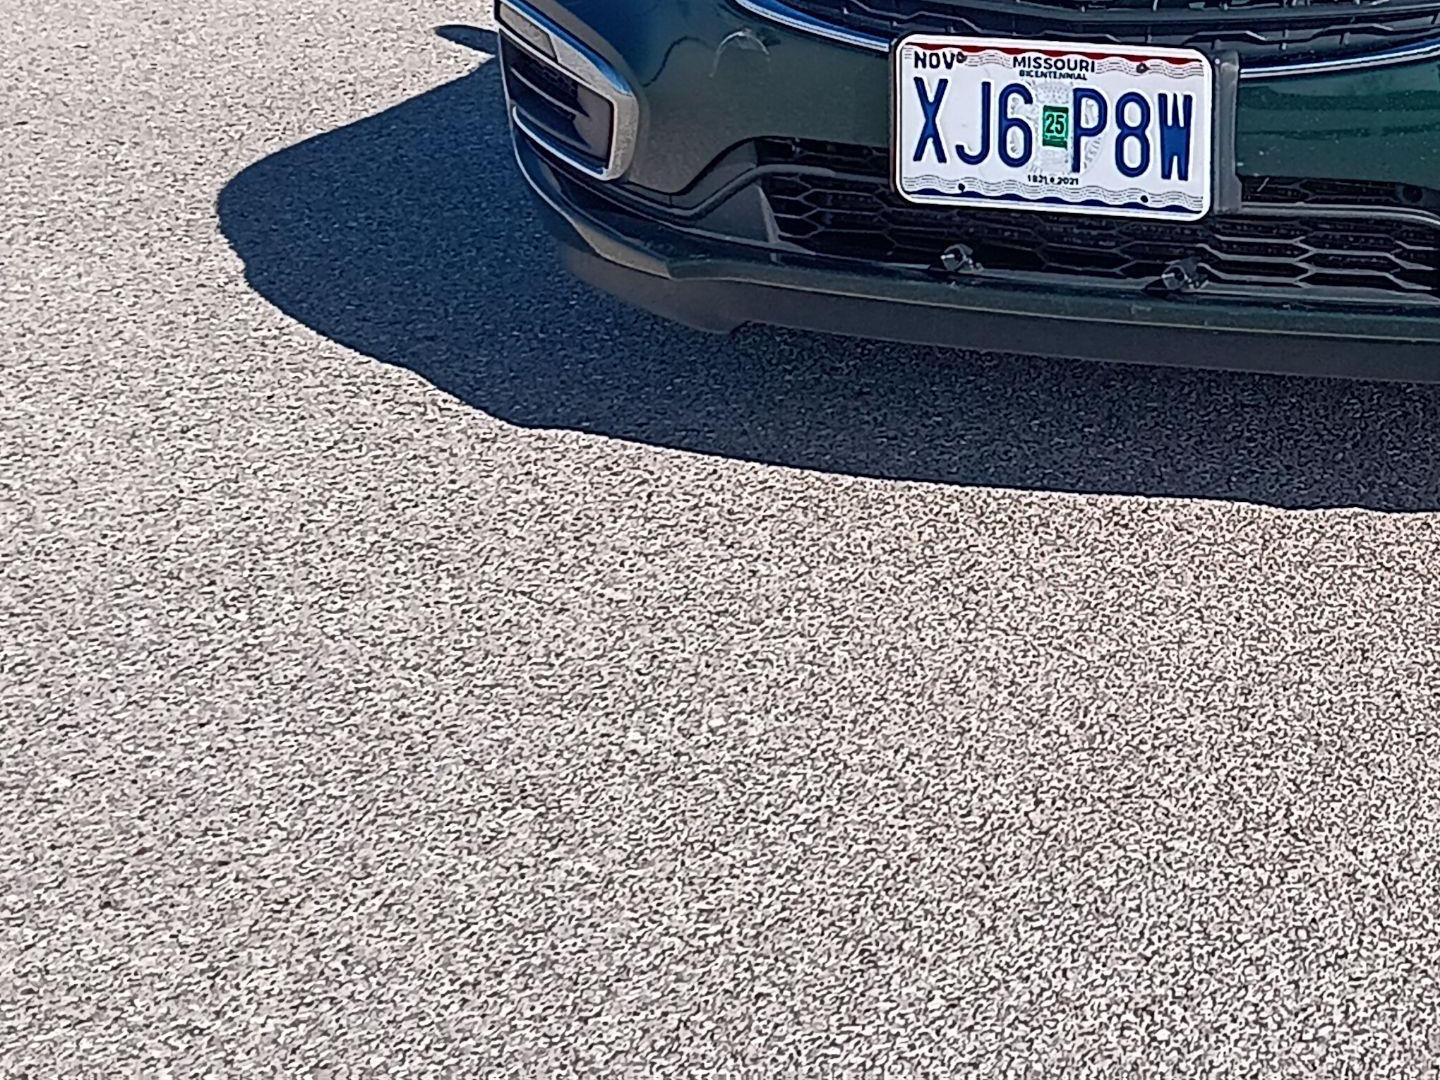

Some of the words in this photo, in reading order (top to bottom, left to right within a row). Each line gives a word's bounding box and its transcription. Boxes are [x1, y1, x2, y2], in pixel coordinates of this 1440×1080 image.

[913, 51, 955, 69] NOV
[1012, 56, 1095, 72] MISSOURI
[1018, 69, 1088, 80] BICENTENNIAL
[912, 76, 1033, 168] XJ6
[1072, 87, 1193, 181] P8W
[1045, 113, 1065, 134] 25
